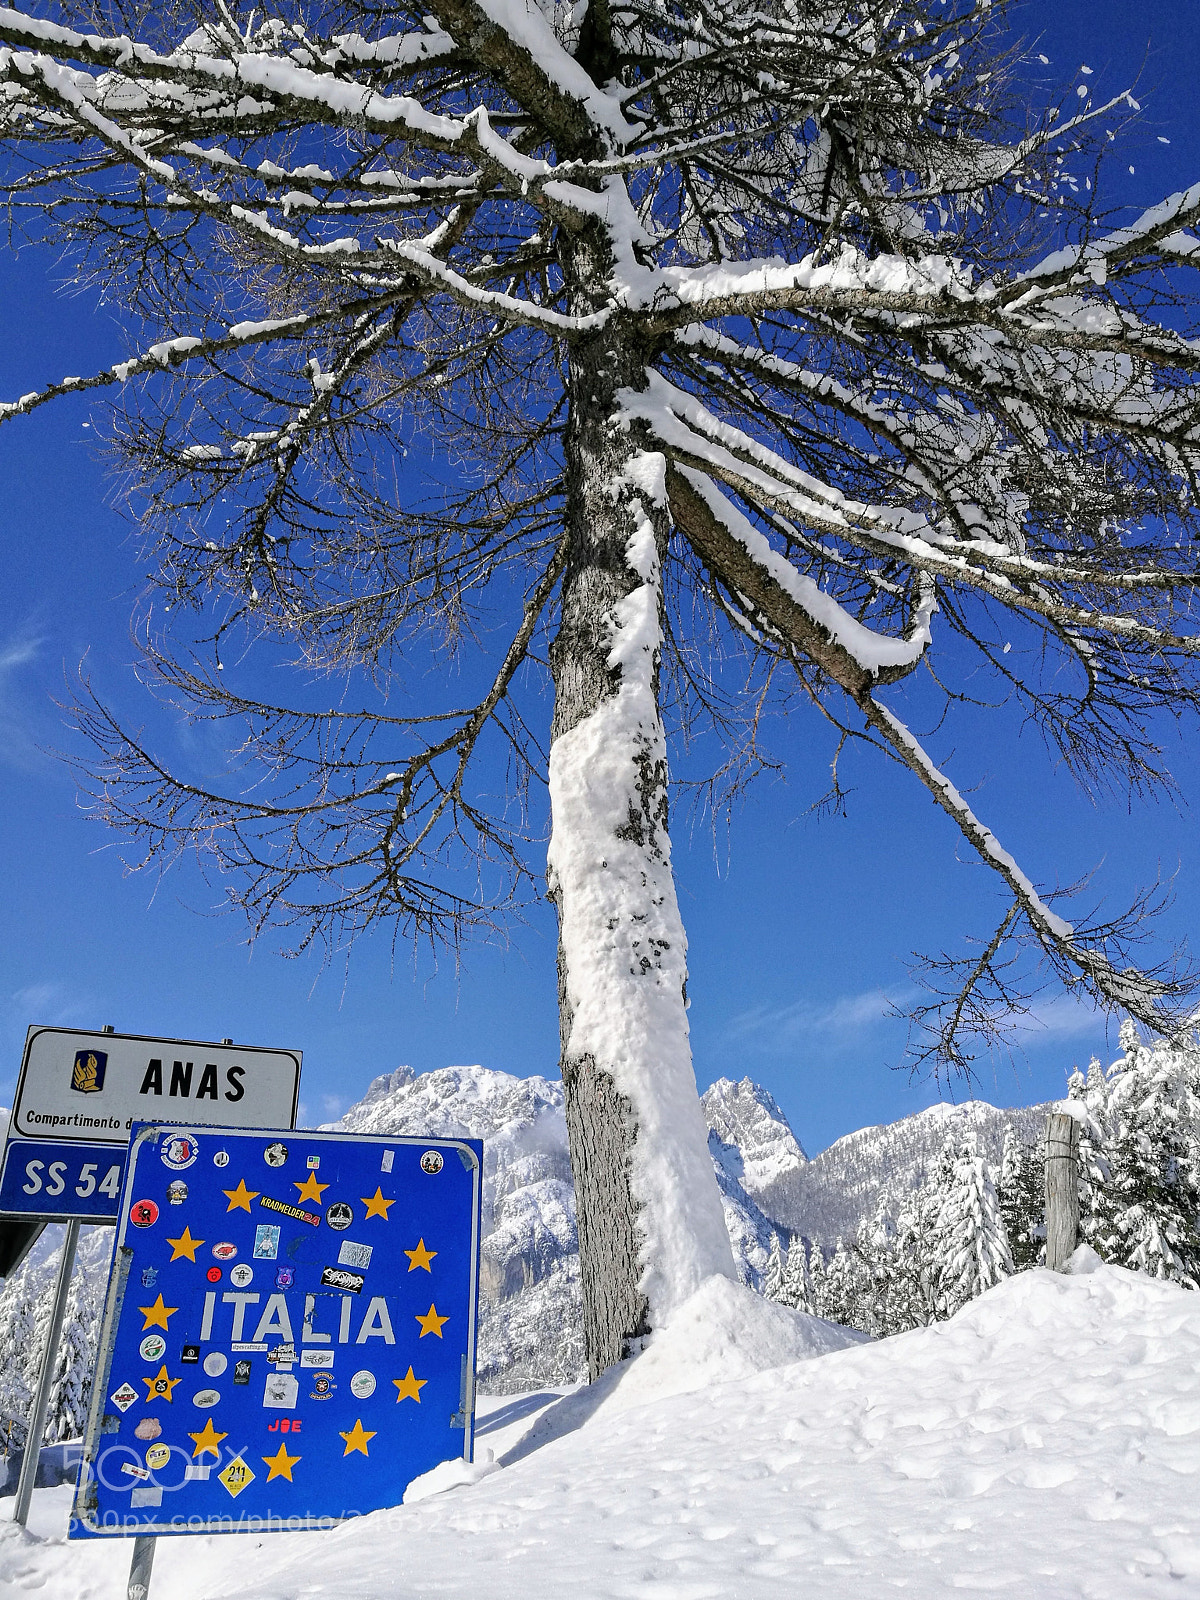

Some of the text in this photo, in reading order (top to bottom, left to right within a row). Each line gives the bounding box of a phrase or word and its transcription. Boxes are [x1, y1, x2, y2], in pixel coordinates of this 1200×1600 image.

[139, 1058, 247, 1102] ANAS
[26, 1110, 121, 1129] Compartimento
[22, 1159, 120, 1199] SS 54
[199, 1291, 396, 1345] ITALIA
